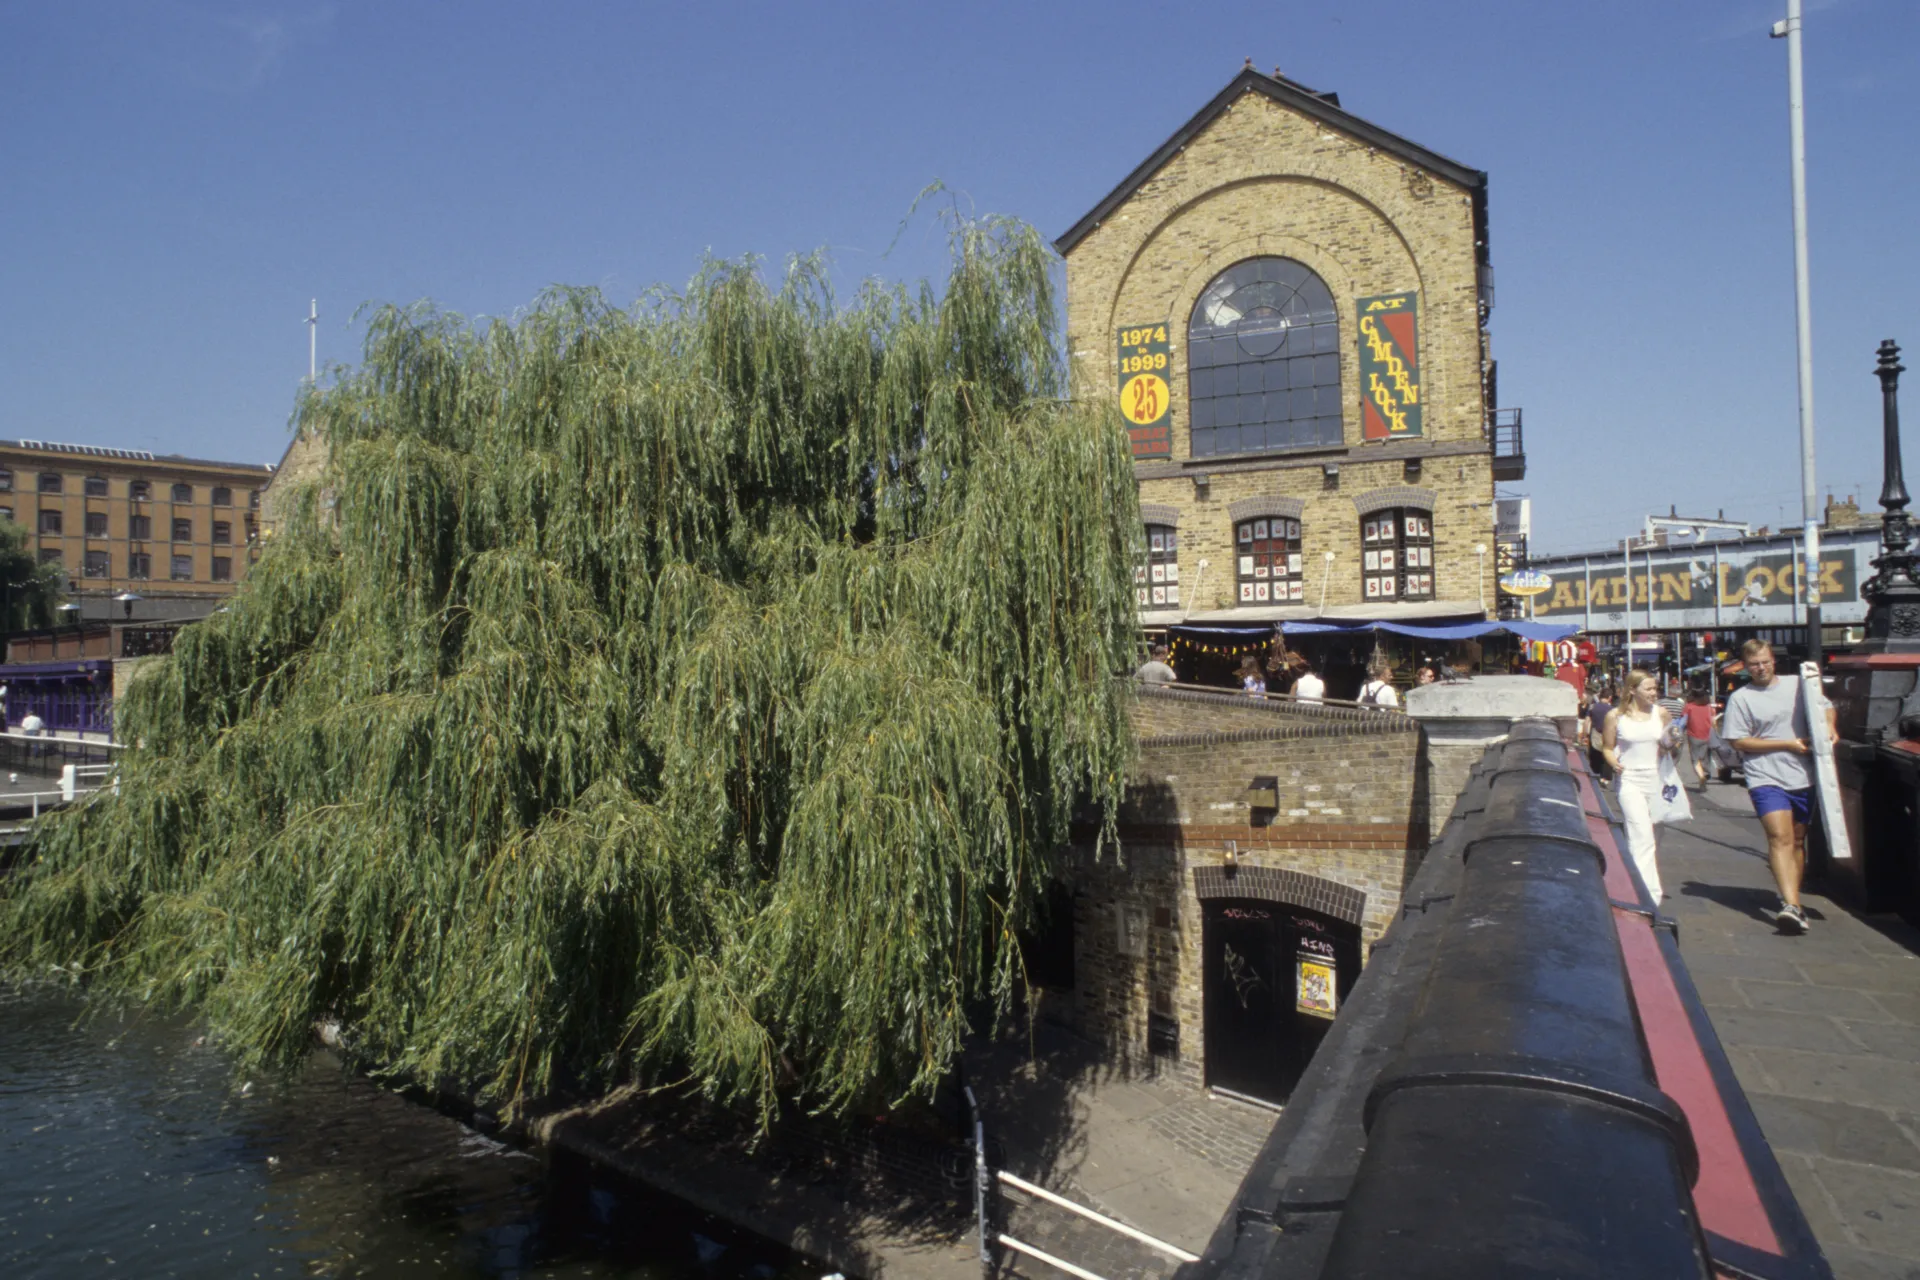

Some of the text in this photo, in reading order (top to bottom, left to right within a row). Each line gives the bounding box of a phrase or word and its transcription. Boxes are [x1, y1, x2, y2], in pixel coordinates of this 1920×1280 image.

[1365, 297, 1406, 311] AT
[1121, 326, 1167, 347] 1974
[1121, 353, 1167, 373] 1999
[1360, 315, 1419, 404] CAMDEN
[1133, 378, 1158, 421] 25
[1369, 372, 1407, 431] LOCK
[1242, 524, 1296, 538] BAGS
[1368, 522, 1429, 536] BAGS
[1712, 560, 1845, 607] LOCK
